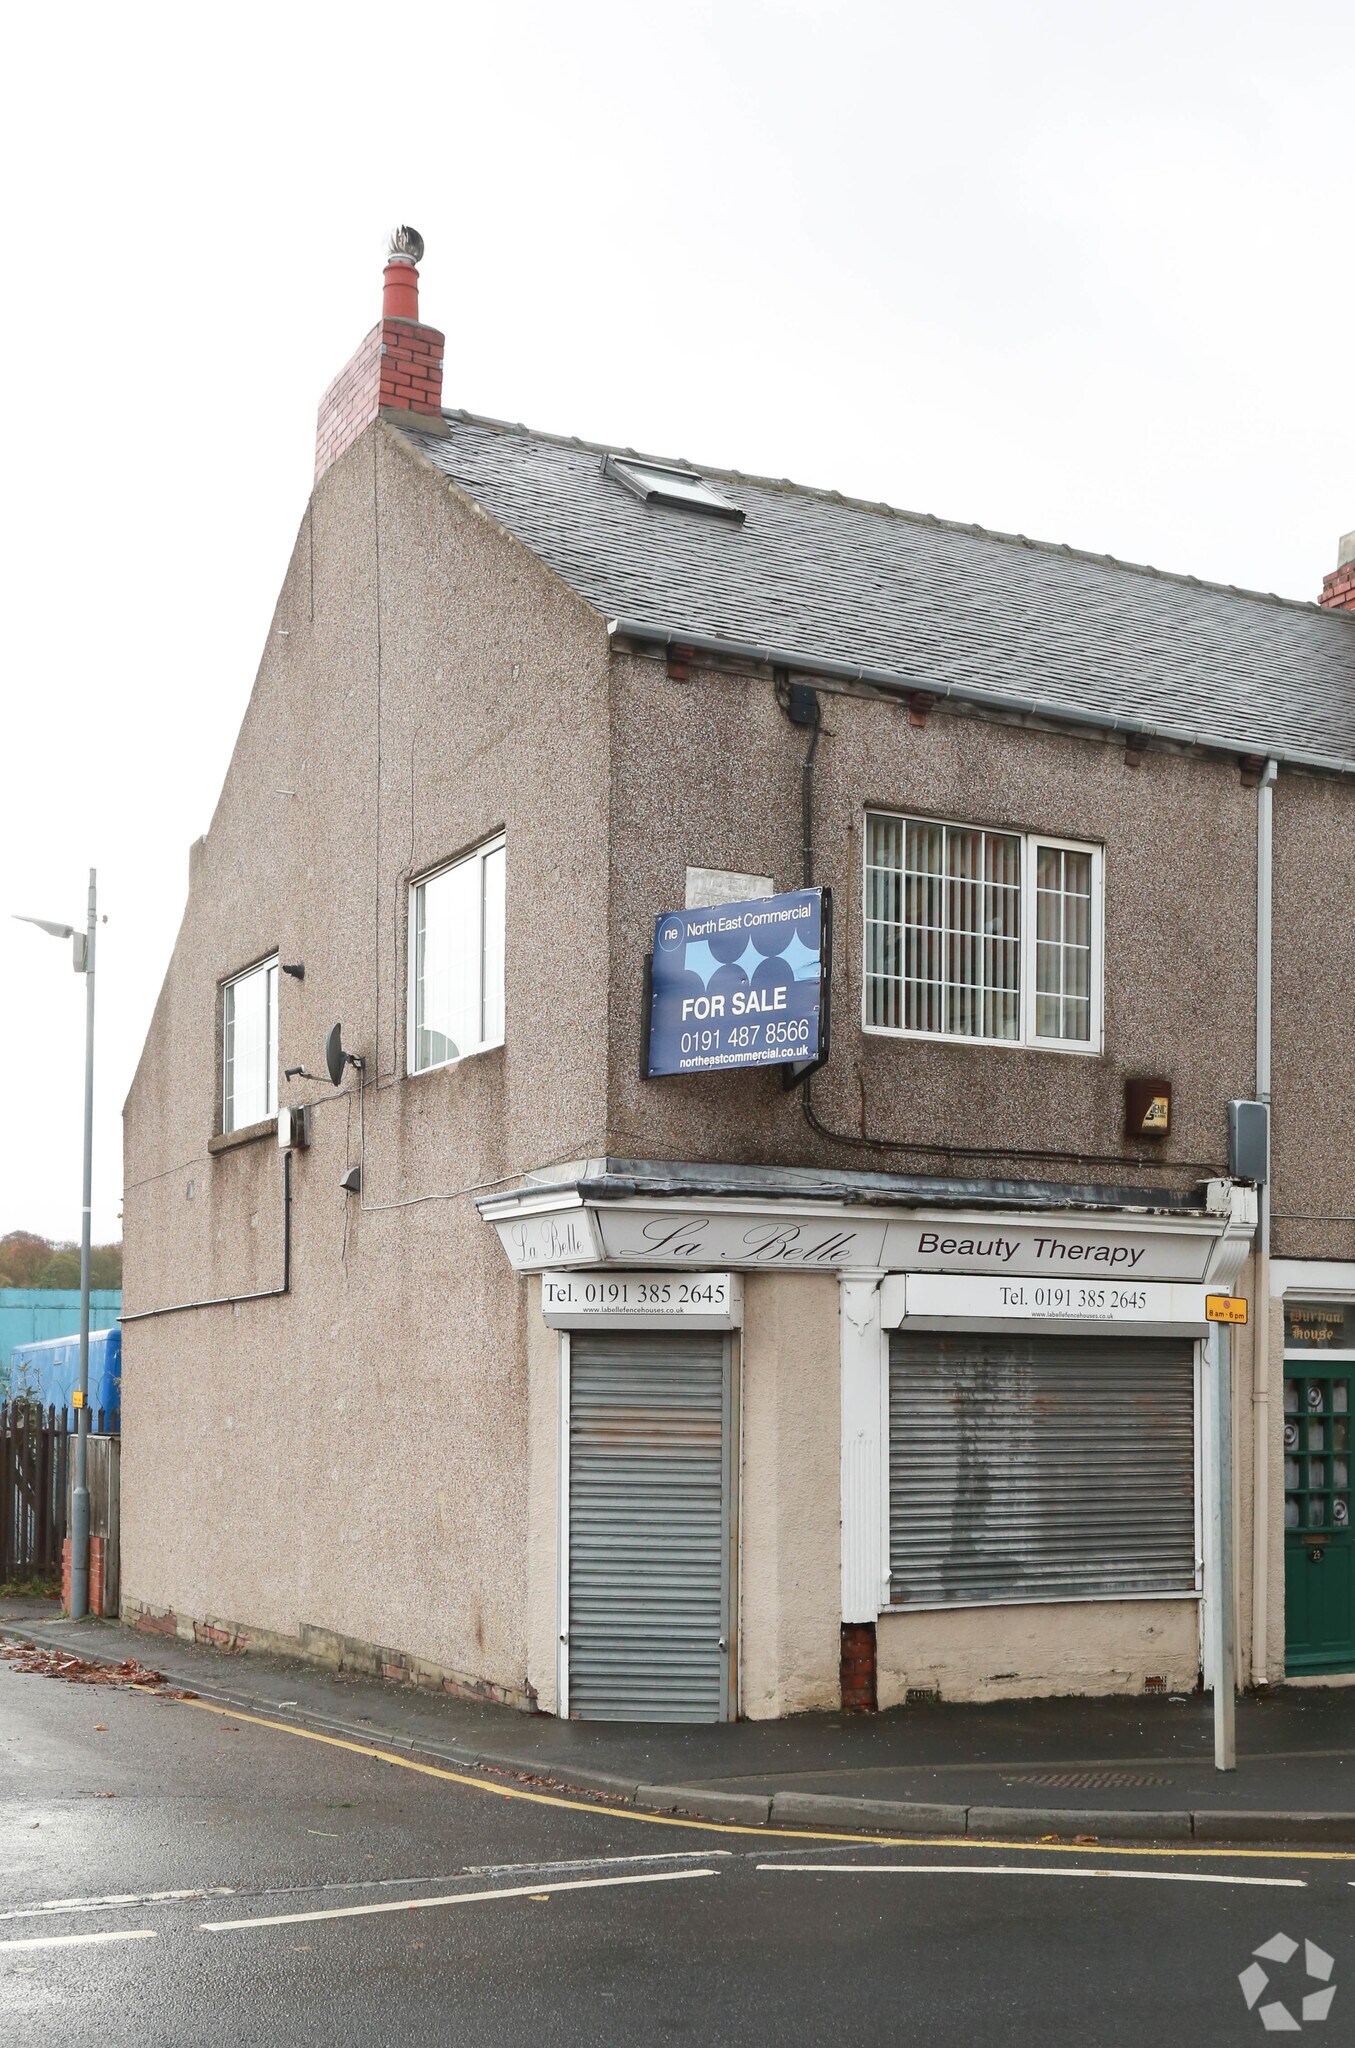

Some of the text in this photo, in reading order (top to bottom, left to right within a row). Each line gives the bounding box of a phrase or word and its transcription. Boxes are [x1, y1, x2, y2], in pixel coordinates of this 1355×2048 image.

[664, 929, 679, 940] ne
[687, 903, 811, 937] North East Commercial
[681, 986, 787, 1021] FOR SALE
[681, 1018, 809, 1053] 0191 487 8566
[679, 1044, 809, 1068] northeastcommercial.co.uk
[511, 1219, 583, 1262] La Belle
[620, 1217, 858, 1261] La Belle
[918, 1233, 1145, 1268] Beauty Therapy
[544, 1283, 725, 1304] Tel. 0191 385 2645
[1000, 1287, 1147, 1309] Tel. 0191 385 2645
[583, 1306, 684, 1314] www.labellefencehouses.co.uk
[1031, 1311, 1114, 1319] www.labellefencehouses.co.uk
